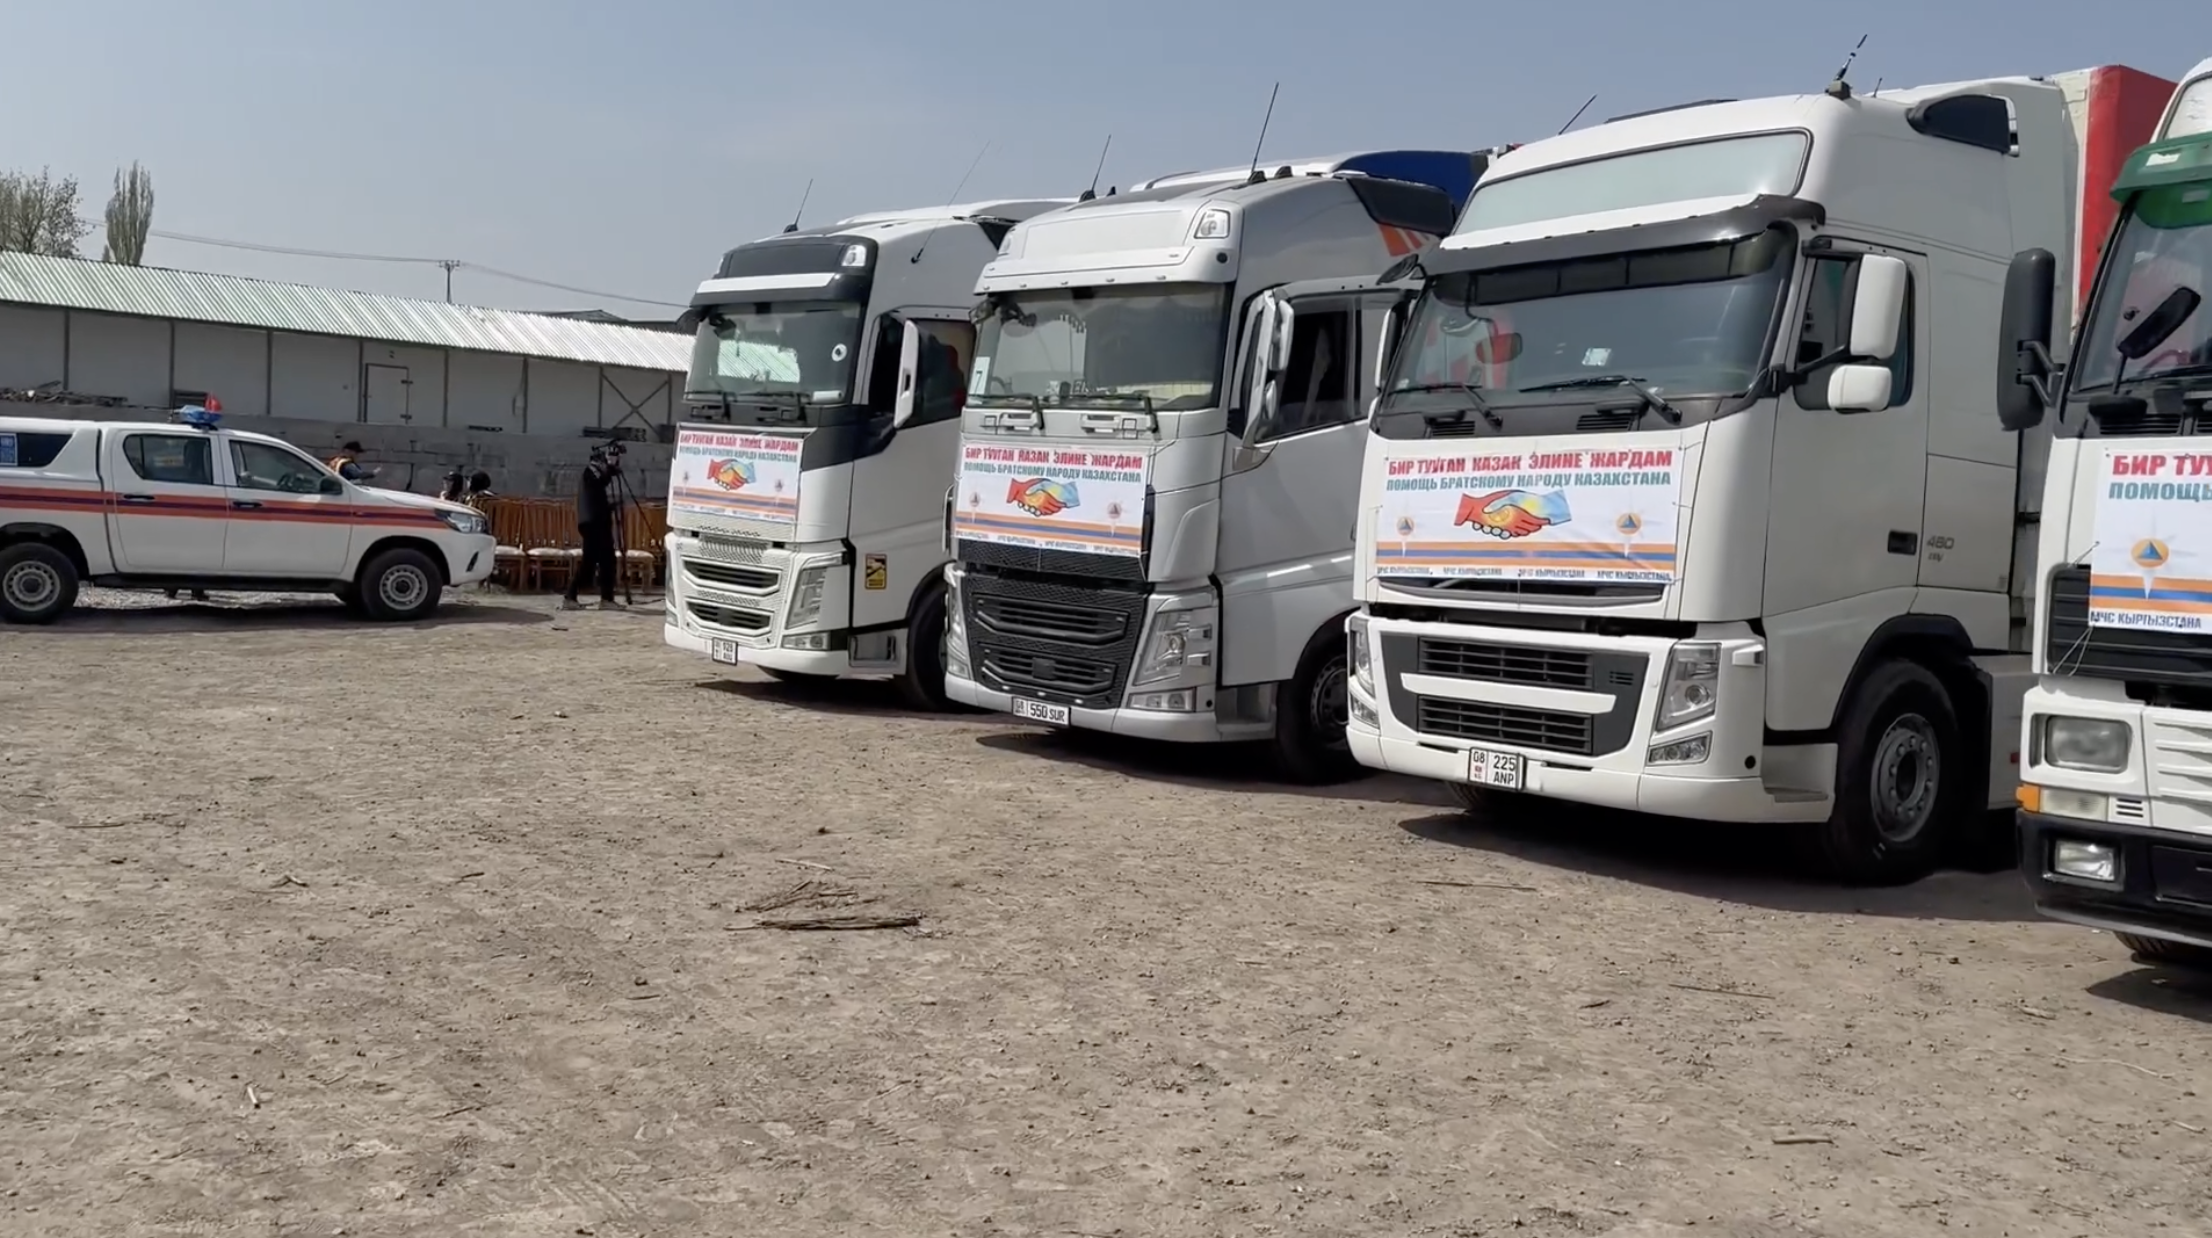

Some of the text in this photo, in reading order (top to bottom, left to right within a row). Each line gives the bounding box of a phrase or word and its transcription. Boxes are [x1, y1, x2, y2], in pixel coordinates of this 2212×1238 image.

[965, 447, 982, 459] БИР
[1053, 452, 1087, 465] ЭЛИНЕ
[1091, 454, 1143, 470] ЖАРДАМ
[1389, 451, 1672, 475] БИР ТУУГАН КАЗАК ЭЛИНЕ ЖАРДАМ
[2112, 455, 2167, 476] БИР
[997, 464, 1045, 476] БРАТСКОМУ
[1046, 467, 1081, 479] НАРОДУ
[1082, 469, 1141, 482] КАЗАХСТАНА
[1386, 472, 1671, 491] ПОМОЩЬ БРАТСКОМУ НАРОДУ КАЗАХСТАНА
[2109, 482, 2212, 502] ПОМОЩЬ
[2090, 611, 2202, 629] МЧС КЫРГЫЗСТАНА
[1030, 703, 1048, 719] 550
[1049, 708, 1065, 722] SUR
[1473, 751, 1516, 771] 08 225
[1493, 771, 1514, 785] ANP
